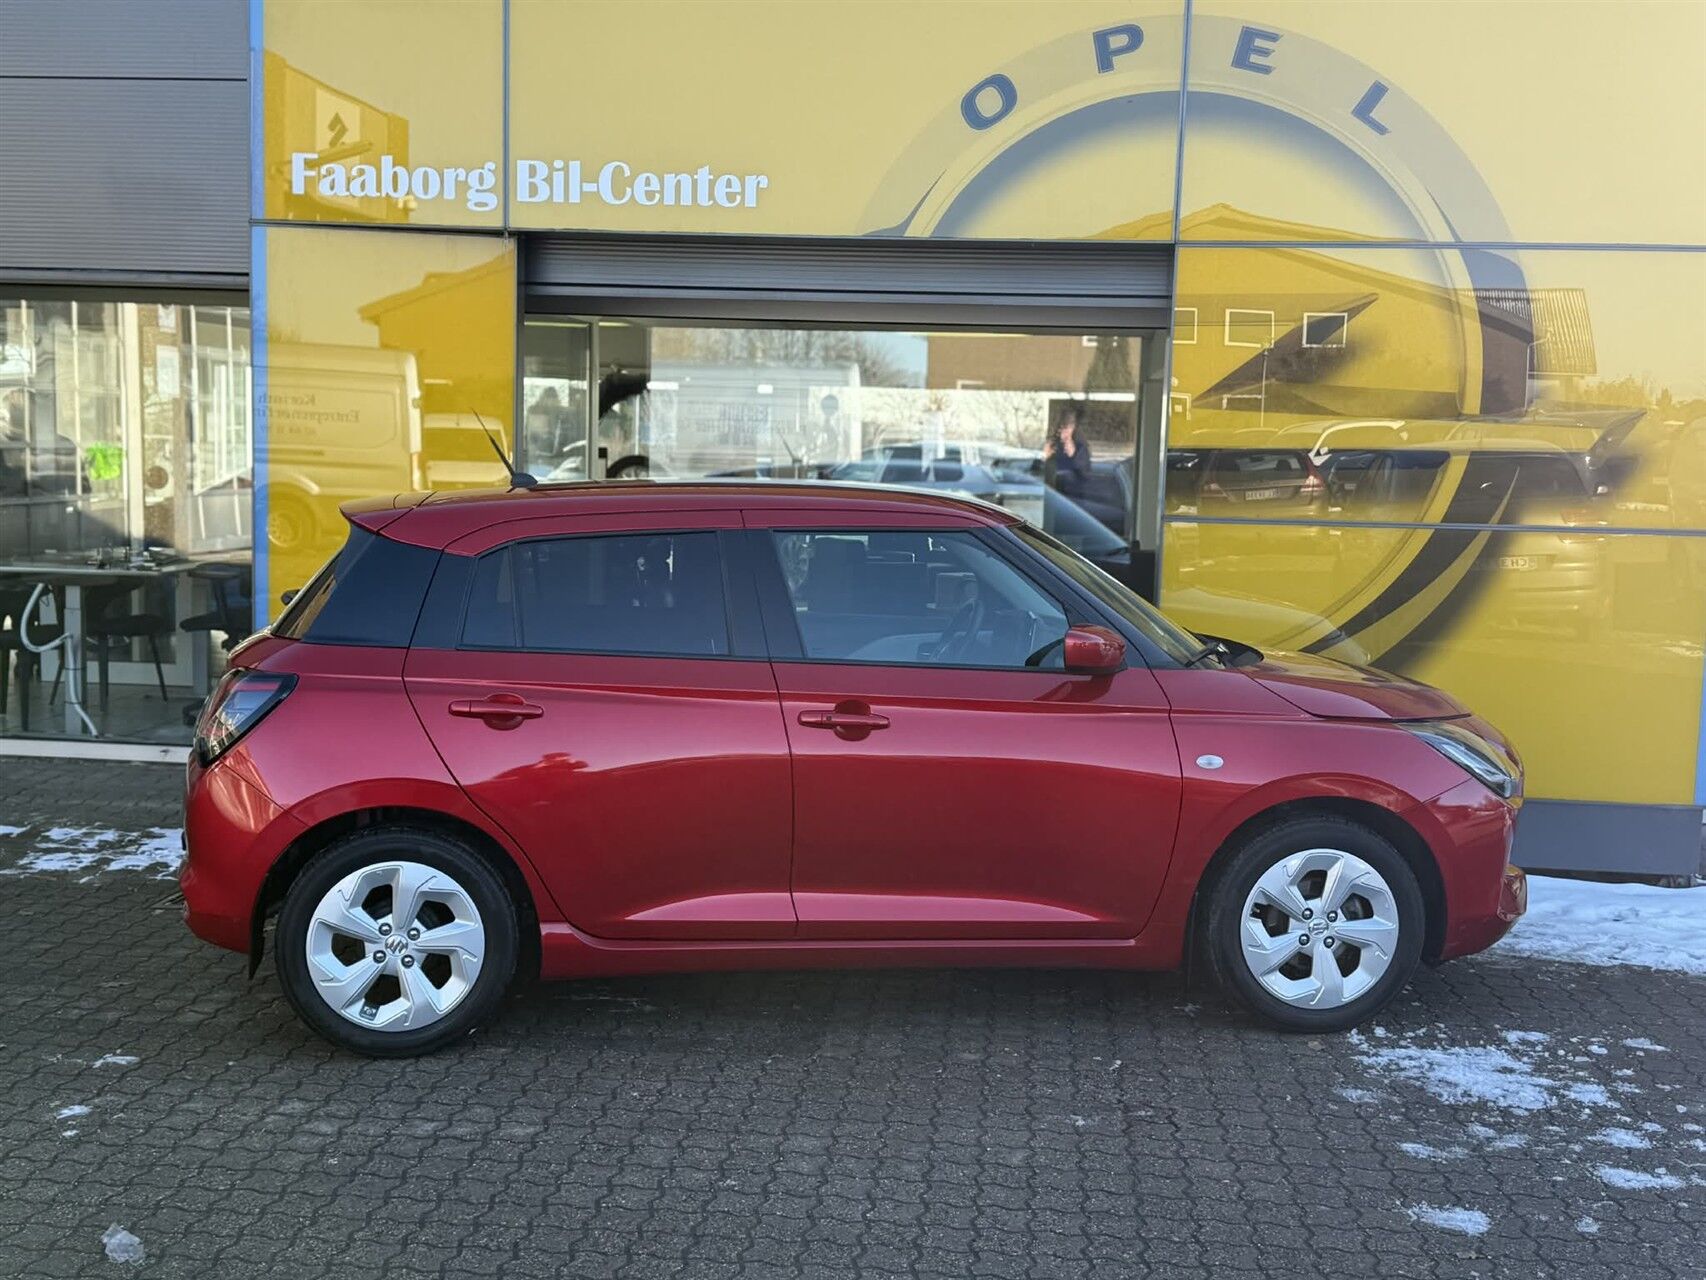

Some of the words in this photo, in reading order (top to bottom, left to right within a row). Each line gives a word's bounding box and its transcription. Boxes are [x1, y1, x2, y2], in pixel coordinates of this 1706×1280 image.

[960, 23, 1391, 136] OPEL
[291, 152, 498, 212] Faaborg
[516, 159, 769, 208] Bil-Center
